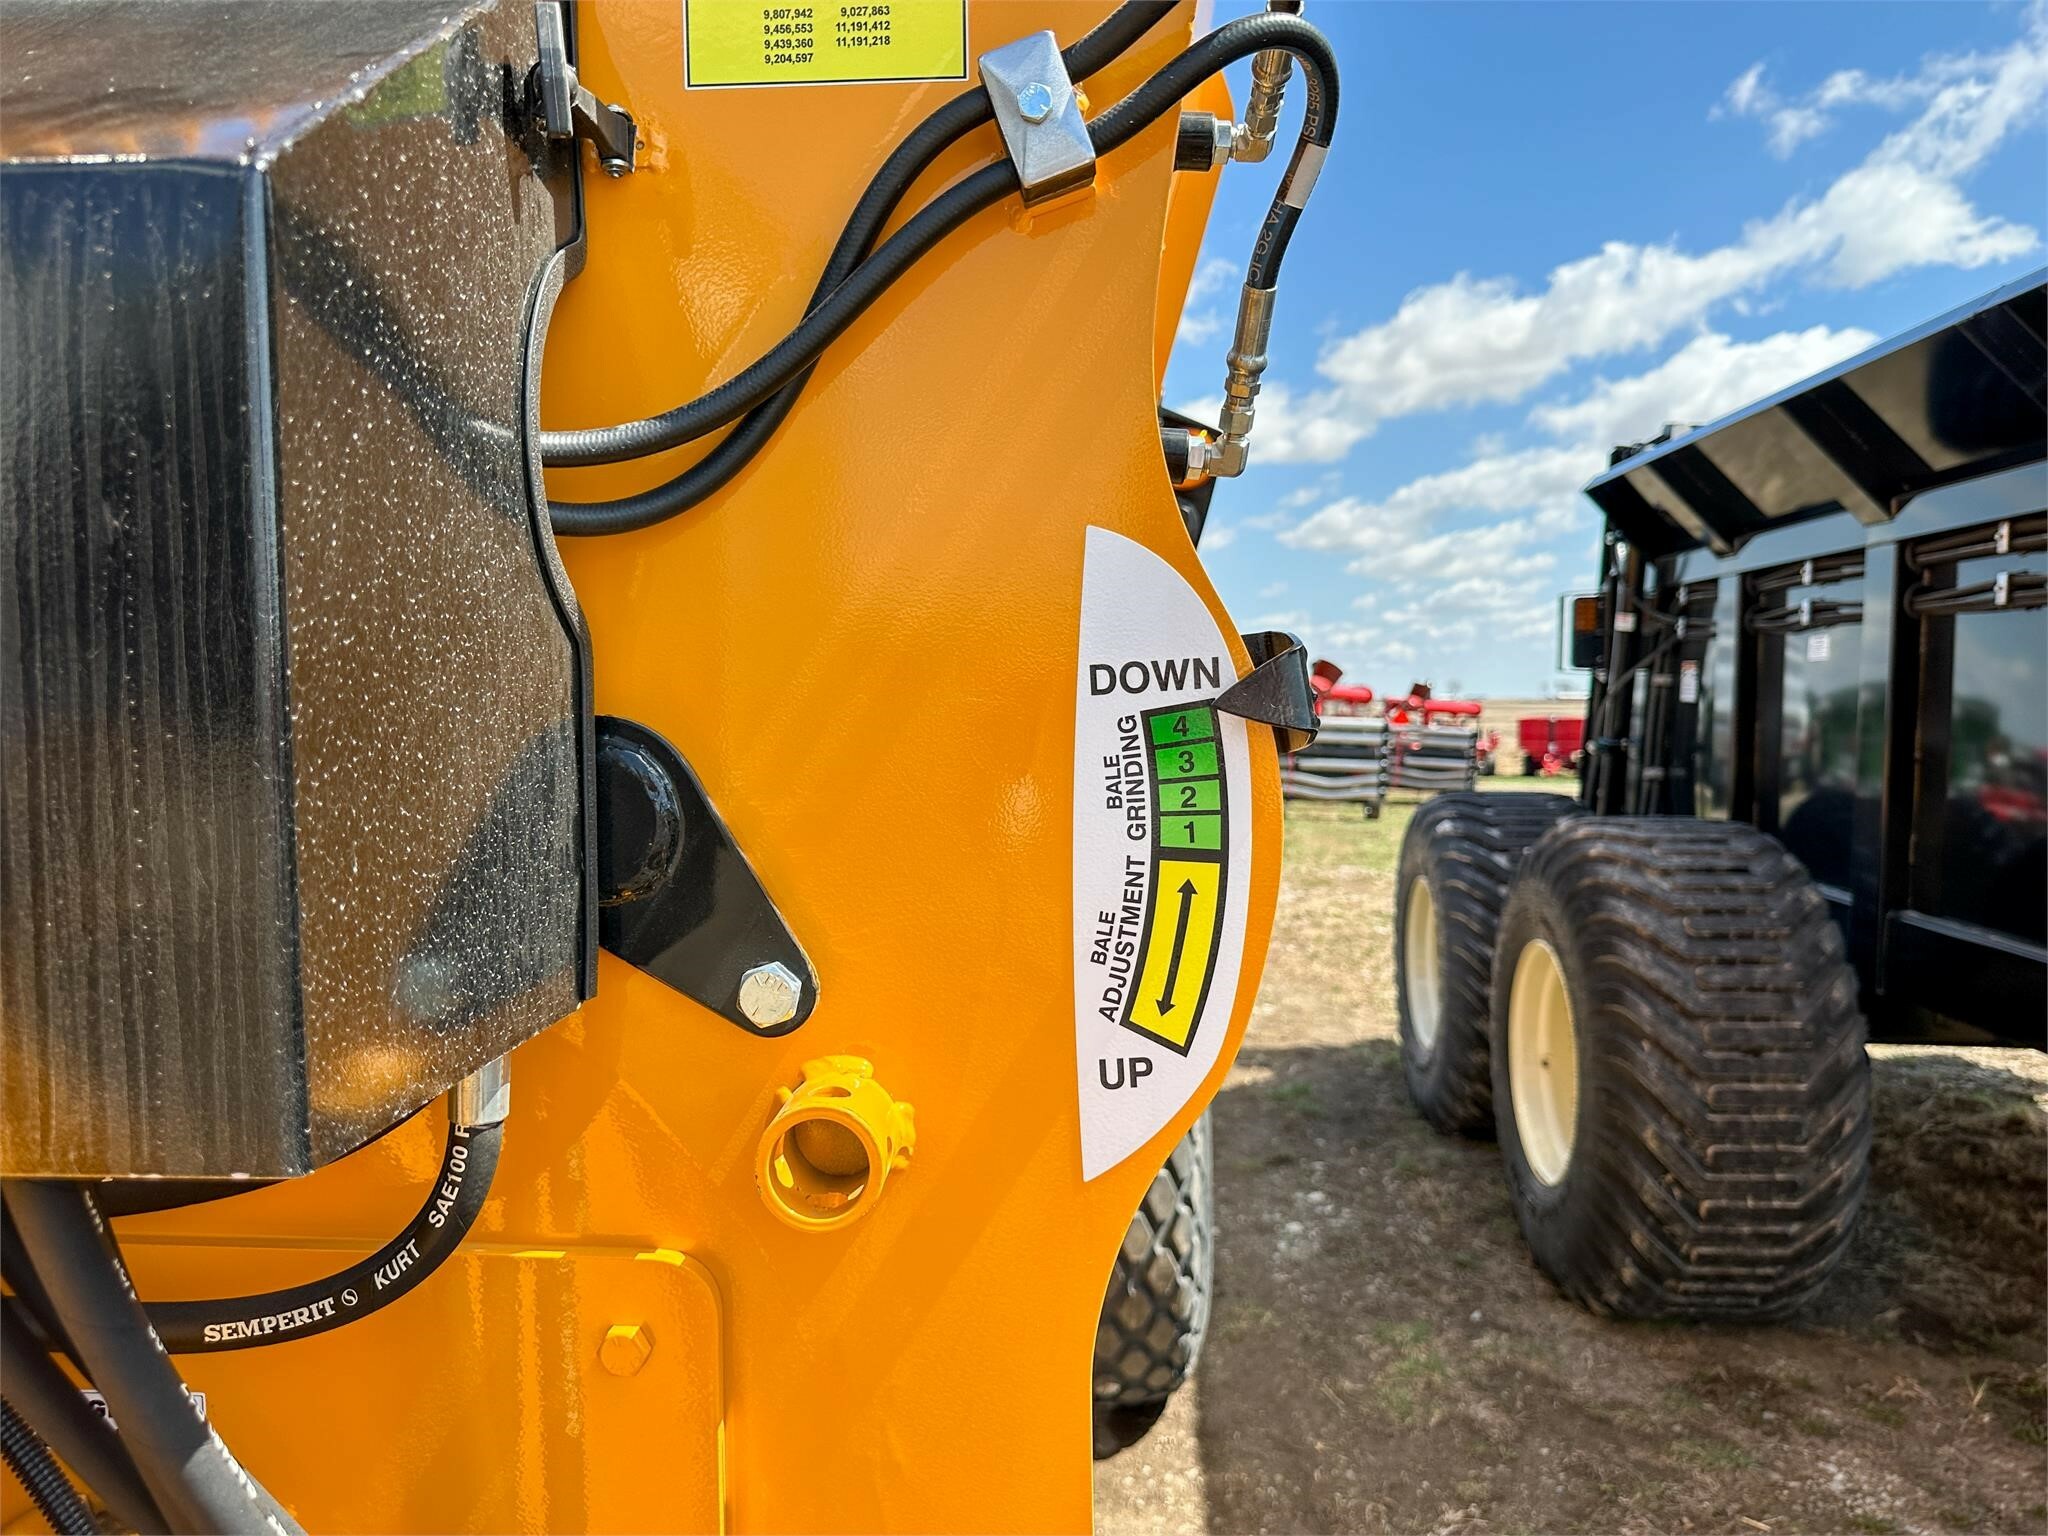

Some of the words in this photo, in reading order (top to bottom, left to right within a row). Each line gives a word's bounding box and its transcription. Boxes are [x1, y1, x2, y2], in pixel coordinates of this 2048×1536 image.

[764, 8, 813, 20] 9,807,942
[840, 6, 890, 17] 9,027,863
[764, 24, 813, 35] 9,456,553
[836, 21, 891, 32] 11,191,412
[764, 38, 813, 50] 9,439,360
[836, 36, 891, 47] 11,191,218
[764, 53, 814, 64] 9,204,597
[1089, 657, 1221, 696] DOWN
[1172, 715, 1190, 737] 4
[1178, 751, 1195, 773] 3
[1103, 754, 1123, 809] BALE
[1117, 714, 1147, 841] GRINDING
[1180, 786, 1197, 808] 2
[1184, 821, 1195, 843] 1
[1091, 910, 1116, 965] BALE
[1098, 855, 1146, 1023] ADJUSTMENT
[1098, 1056, 1153, 1090] UP
[203, 1297, 337, 1343] SEMPERIT
[373, 1238, 421, 1291] KURT
[428, 1144, 469, 1228] SAE100
